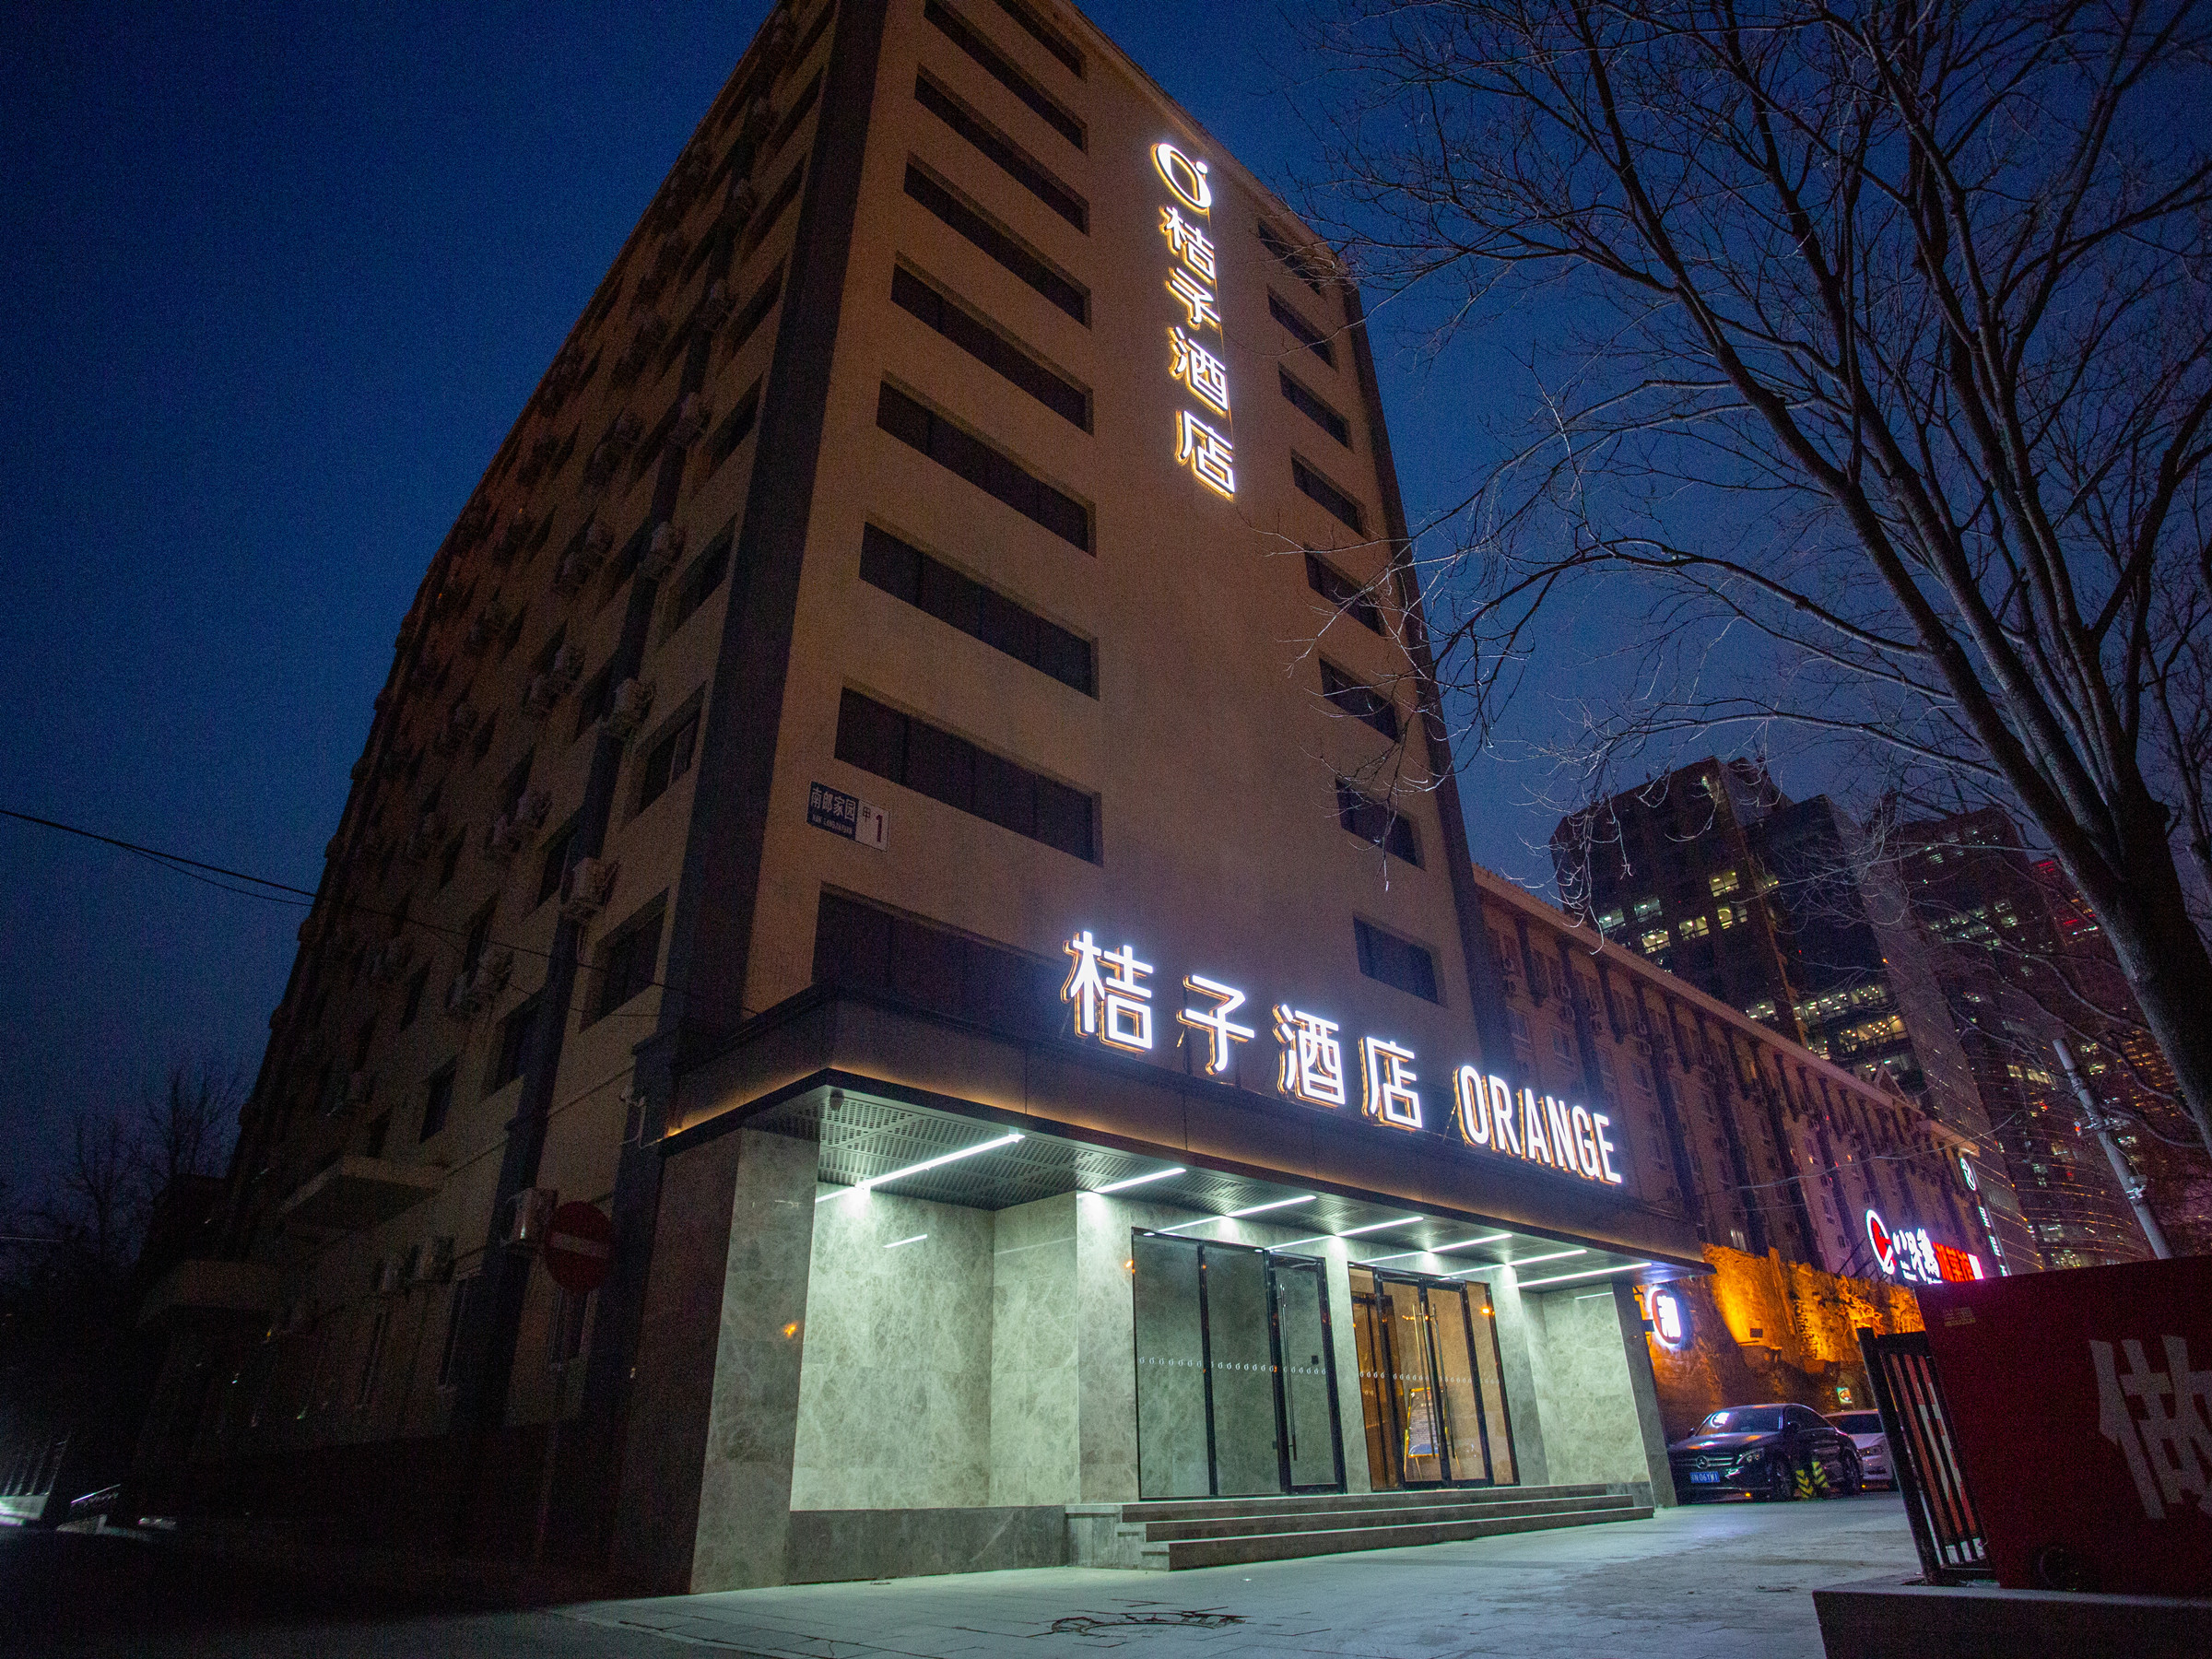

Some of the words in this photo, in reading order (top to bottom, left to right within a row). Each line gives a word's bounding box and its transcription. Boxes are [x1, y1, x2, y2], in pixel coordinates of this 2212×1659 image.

[1160, 206, 1235, 497] 桔子酒店
[811, 787, 856, 822] 南郎家园
[1062, 930, 1424, 1131] 桔子酒店
[1453, 1065, 1623, 1184] ORANGE
